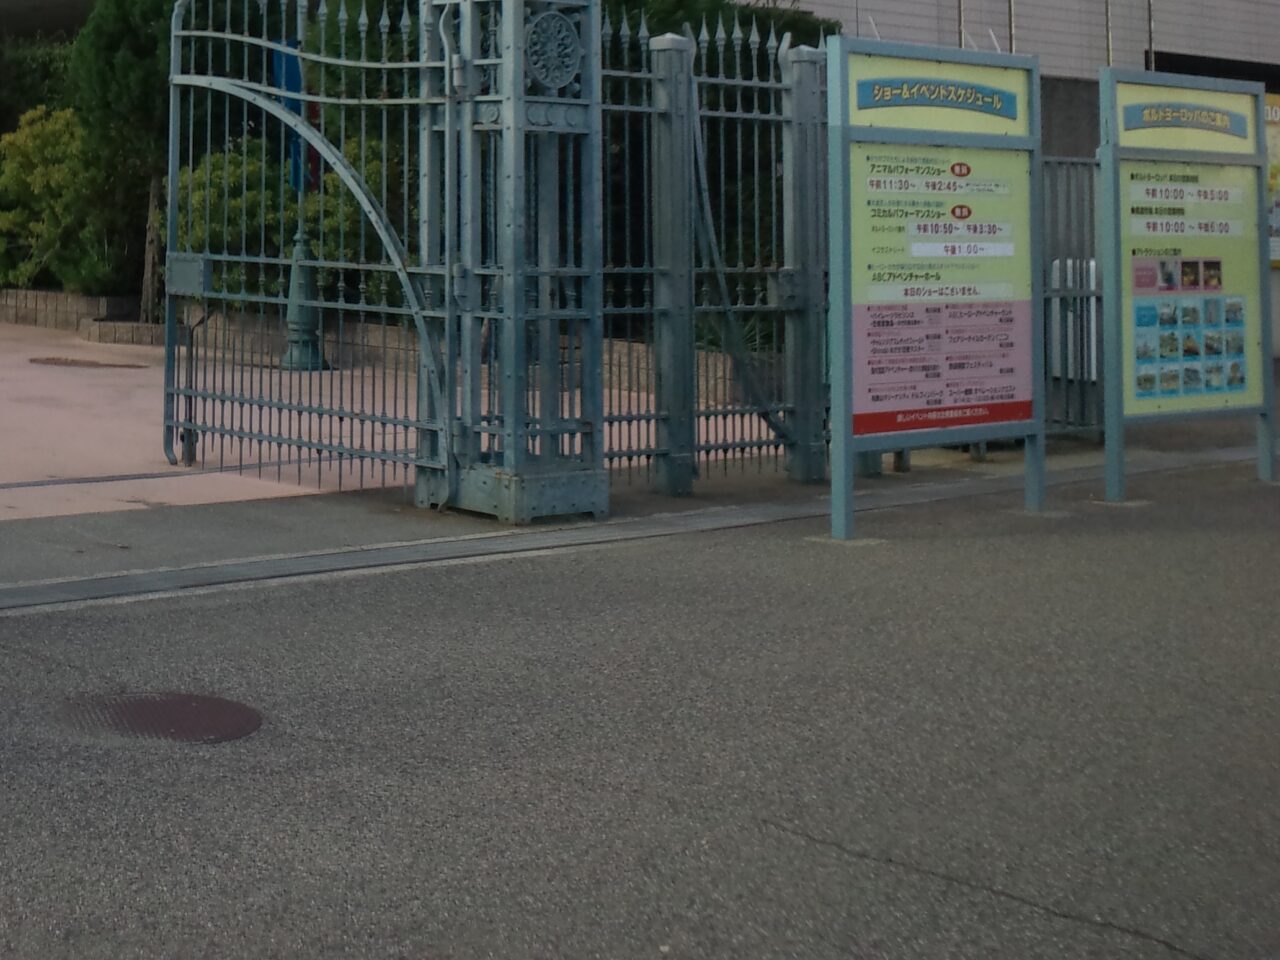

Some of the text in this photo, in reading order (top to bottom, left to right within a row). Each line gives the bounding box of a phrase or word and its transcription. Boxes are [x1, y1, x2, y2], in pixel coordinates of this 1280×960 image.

[872, 82, 1003, 110] ショー&イベントスケジュール
[1141, 107, 1231, 130] ポルトヨーロッパのご案内
[870, 163, 947, 176] アニマルパフォーマンスショー
[871, 208, 947, 220] コミカルパフォーマンスショー
